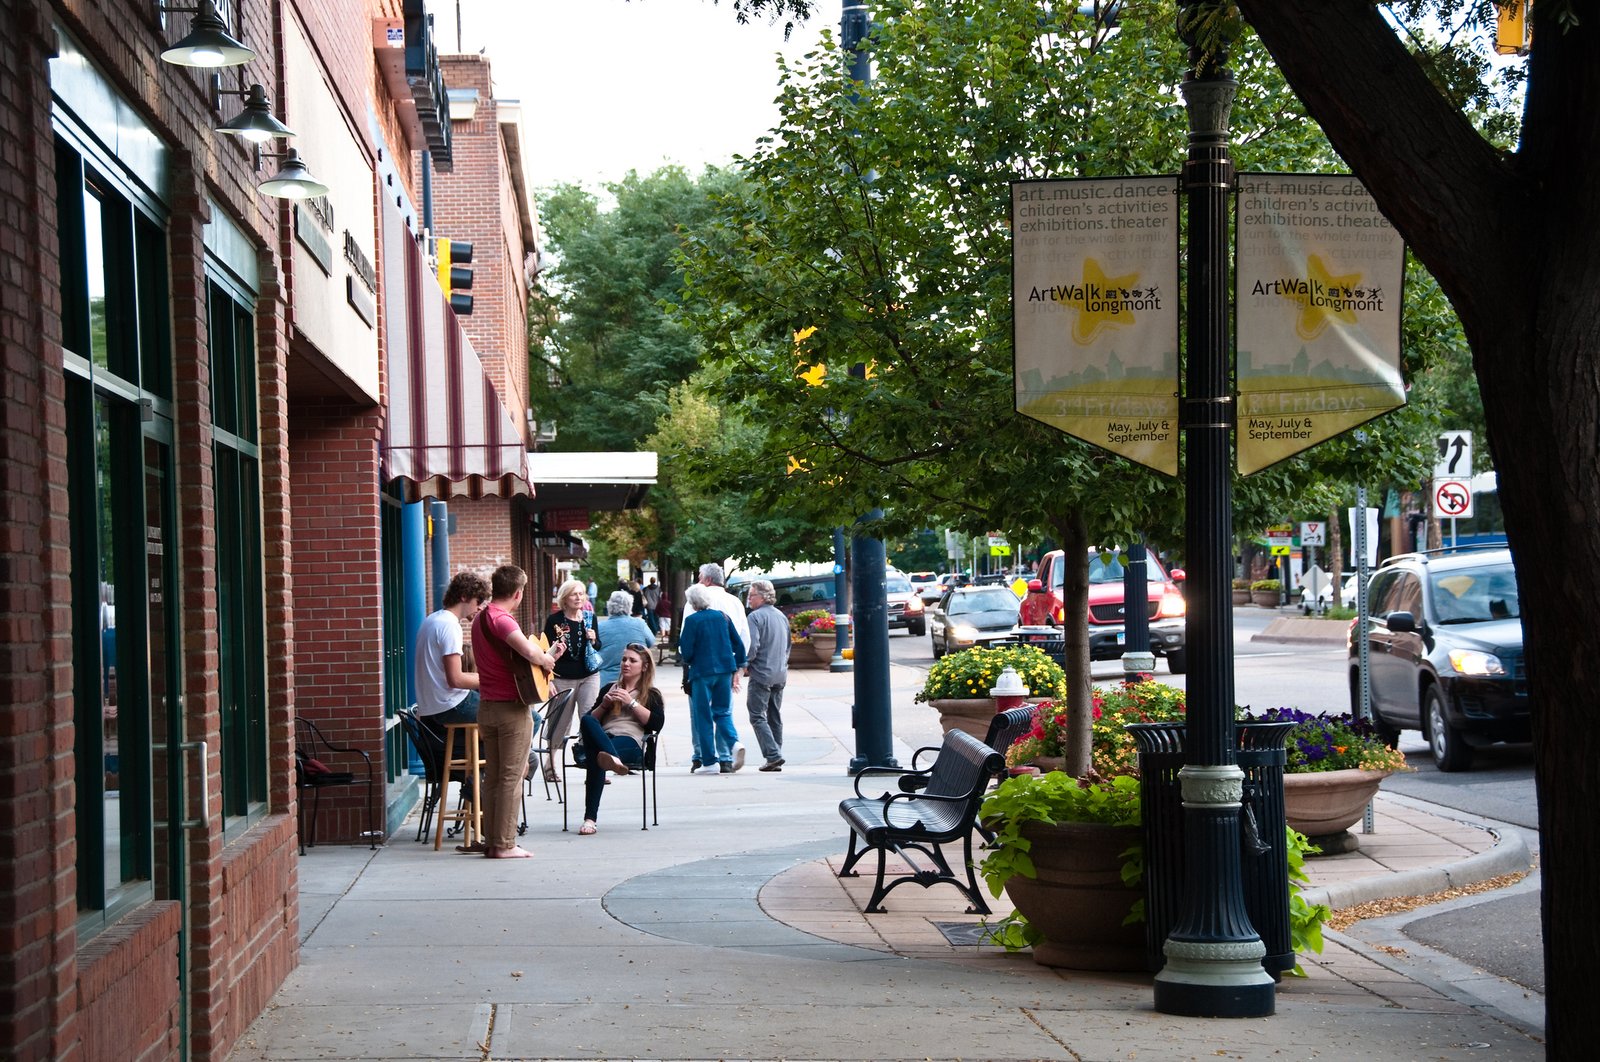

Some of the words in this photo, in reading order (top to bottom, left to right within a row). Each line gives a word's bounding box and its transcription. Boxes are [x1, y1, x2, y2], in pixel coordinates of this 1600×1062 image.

[1245, 180, 1370, 196] art.music.da
[1019, 203, 1093, 218] children's
[1098, 200, 1169, 214] activities
[1244, 197, 1319, 212] children's
[1324, 199, 1378, 213] activit
[1029, 283, 1101, 302] ArtWalk
[1252, 278, 1324, 296] ArtWalk
[1107, 422, 1132, 434] May,
[1135, 421, 1158, 434] July
[1161, 420, 1170, 430] &
[1248, 418, 1274, 430] May,
[1276, 418, 1301, 431] July
[1303, 418, 1312, 428] &
[1107, 431, 1170, 444] September
[1248, 429, 1313, 442] September
